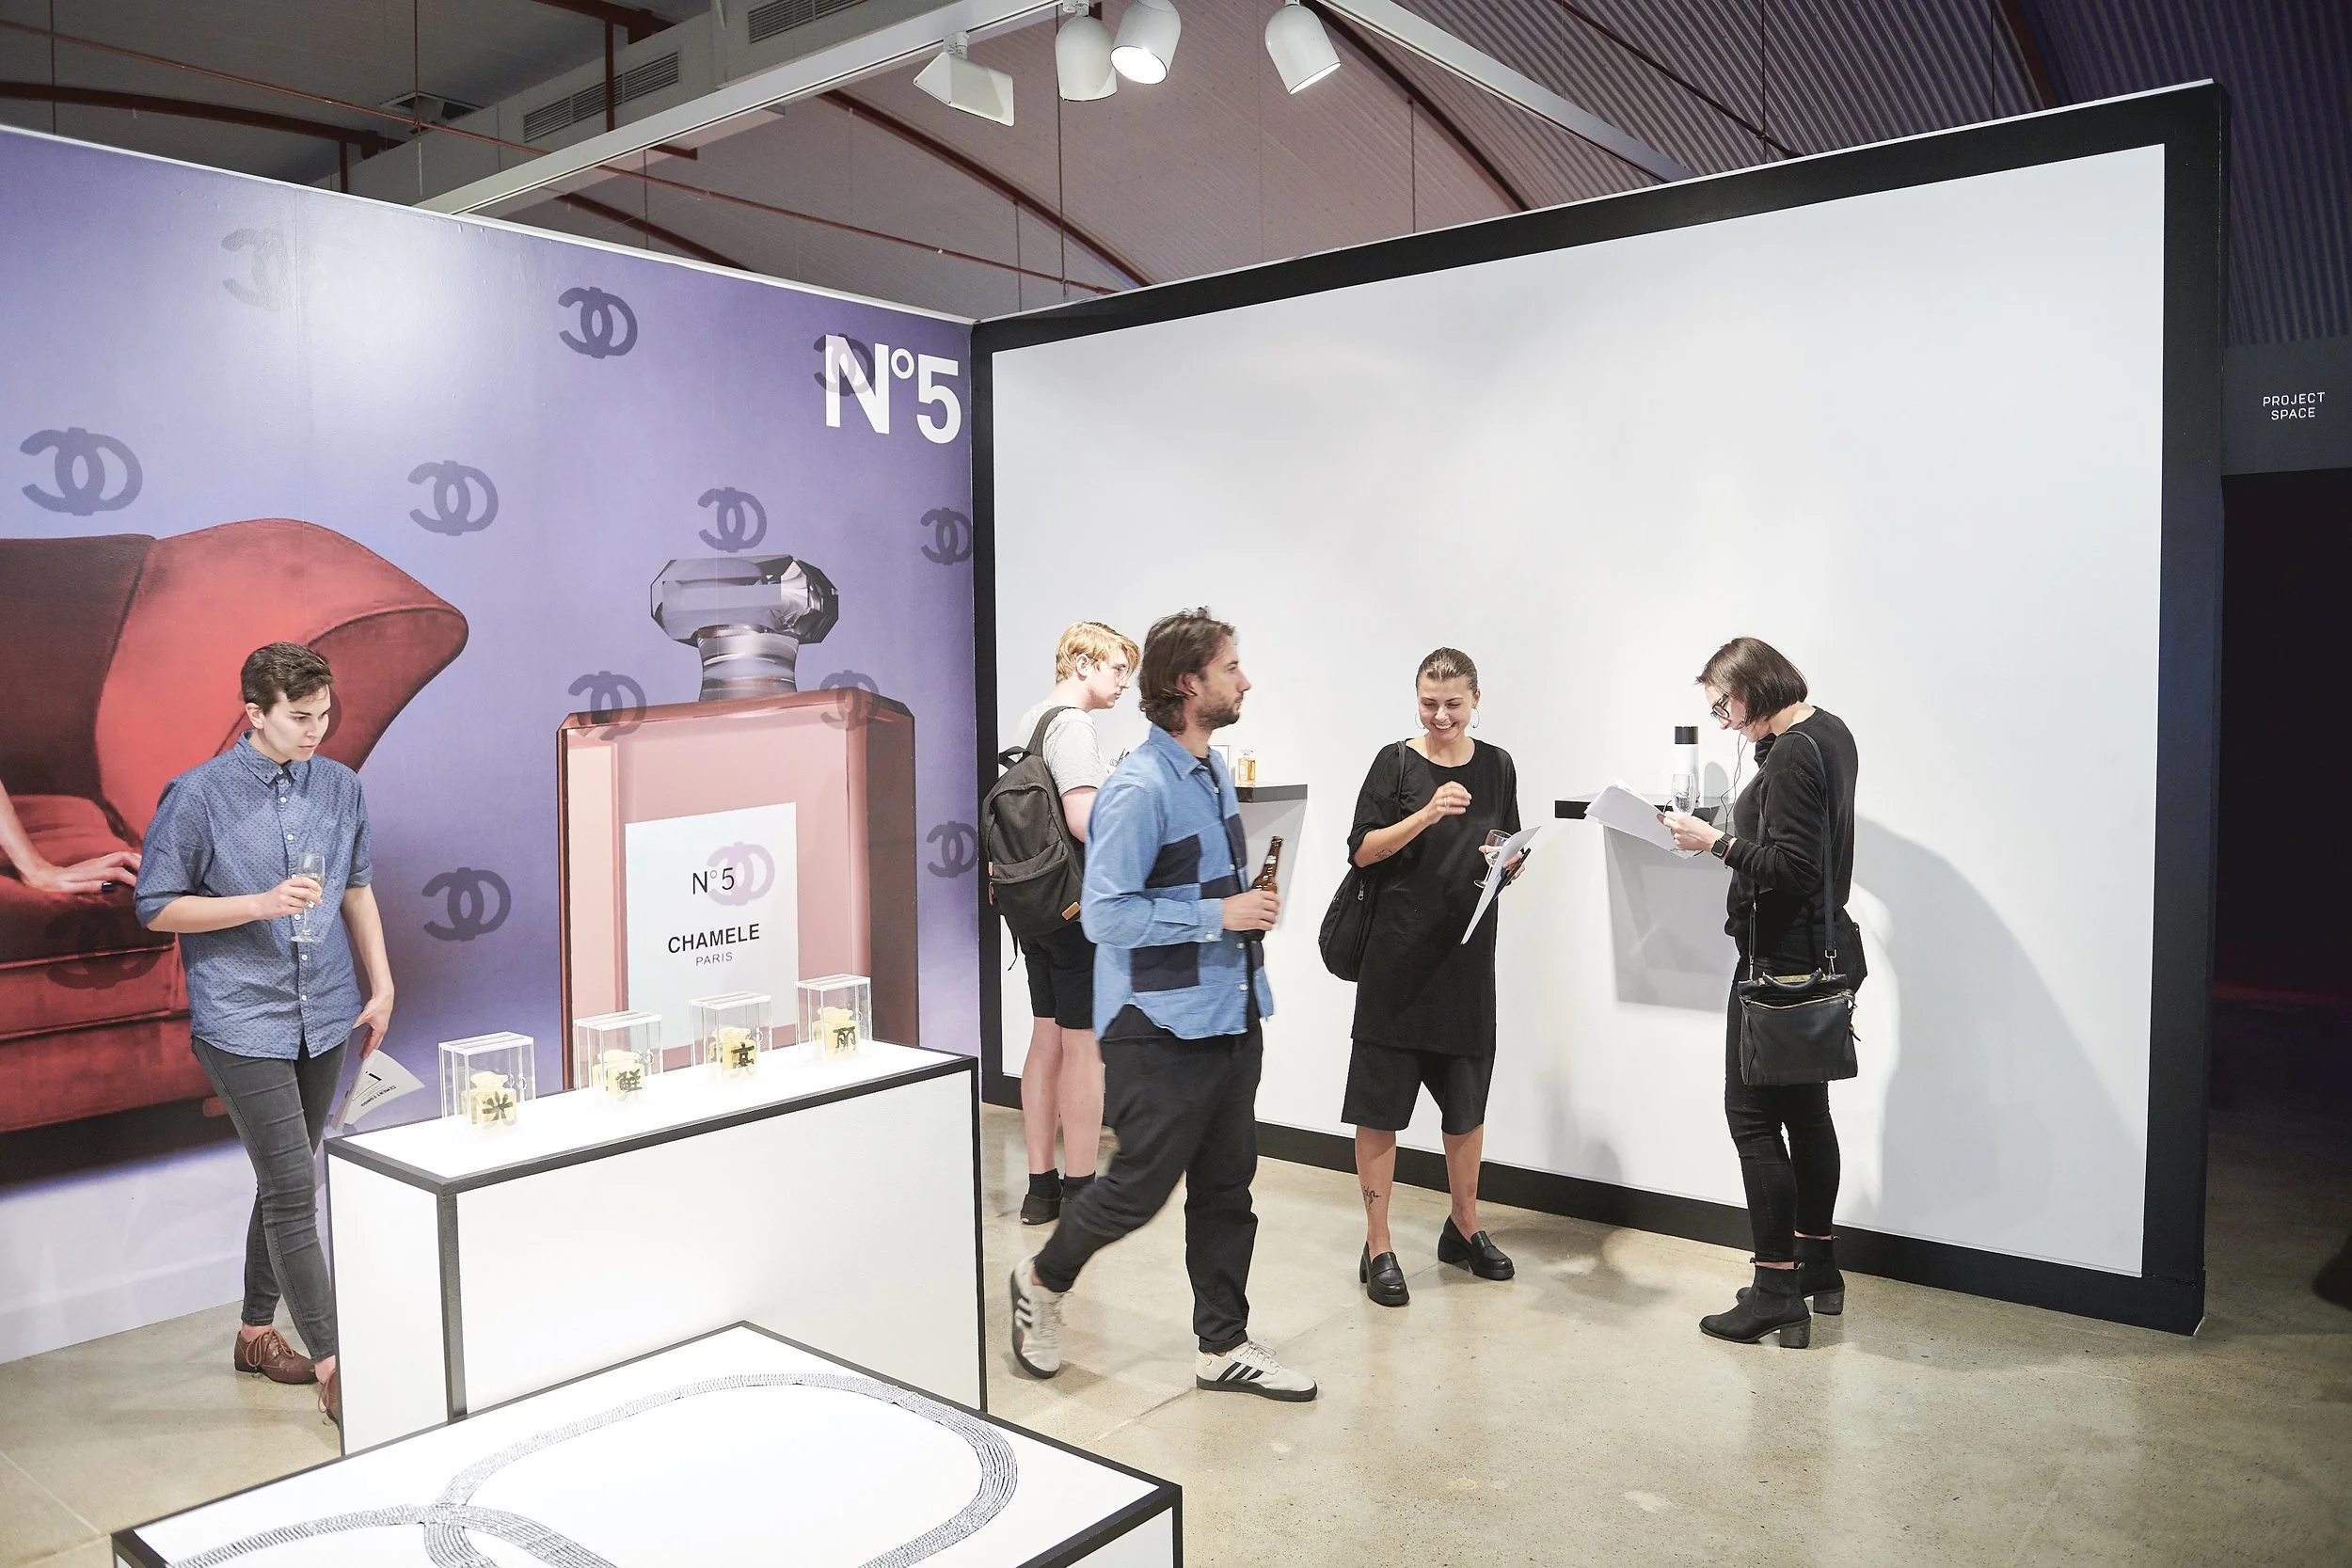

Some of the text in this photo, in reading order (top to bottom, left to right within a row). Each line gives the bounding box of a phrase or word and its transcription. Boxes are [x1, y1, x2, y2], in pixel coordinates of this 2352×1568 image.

[2263, 391, 2326, 406] PROJECT
[2271, 407, 2316, 420] SPACE
[668, 924, 760, 954] CHAMELE
[695, 952, 733, 966] PARIS
